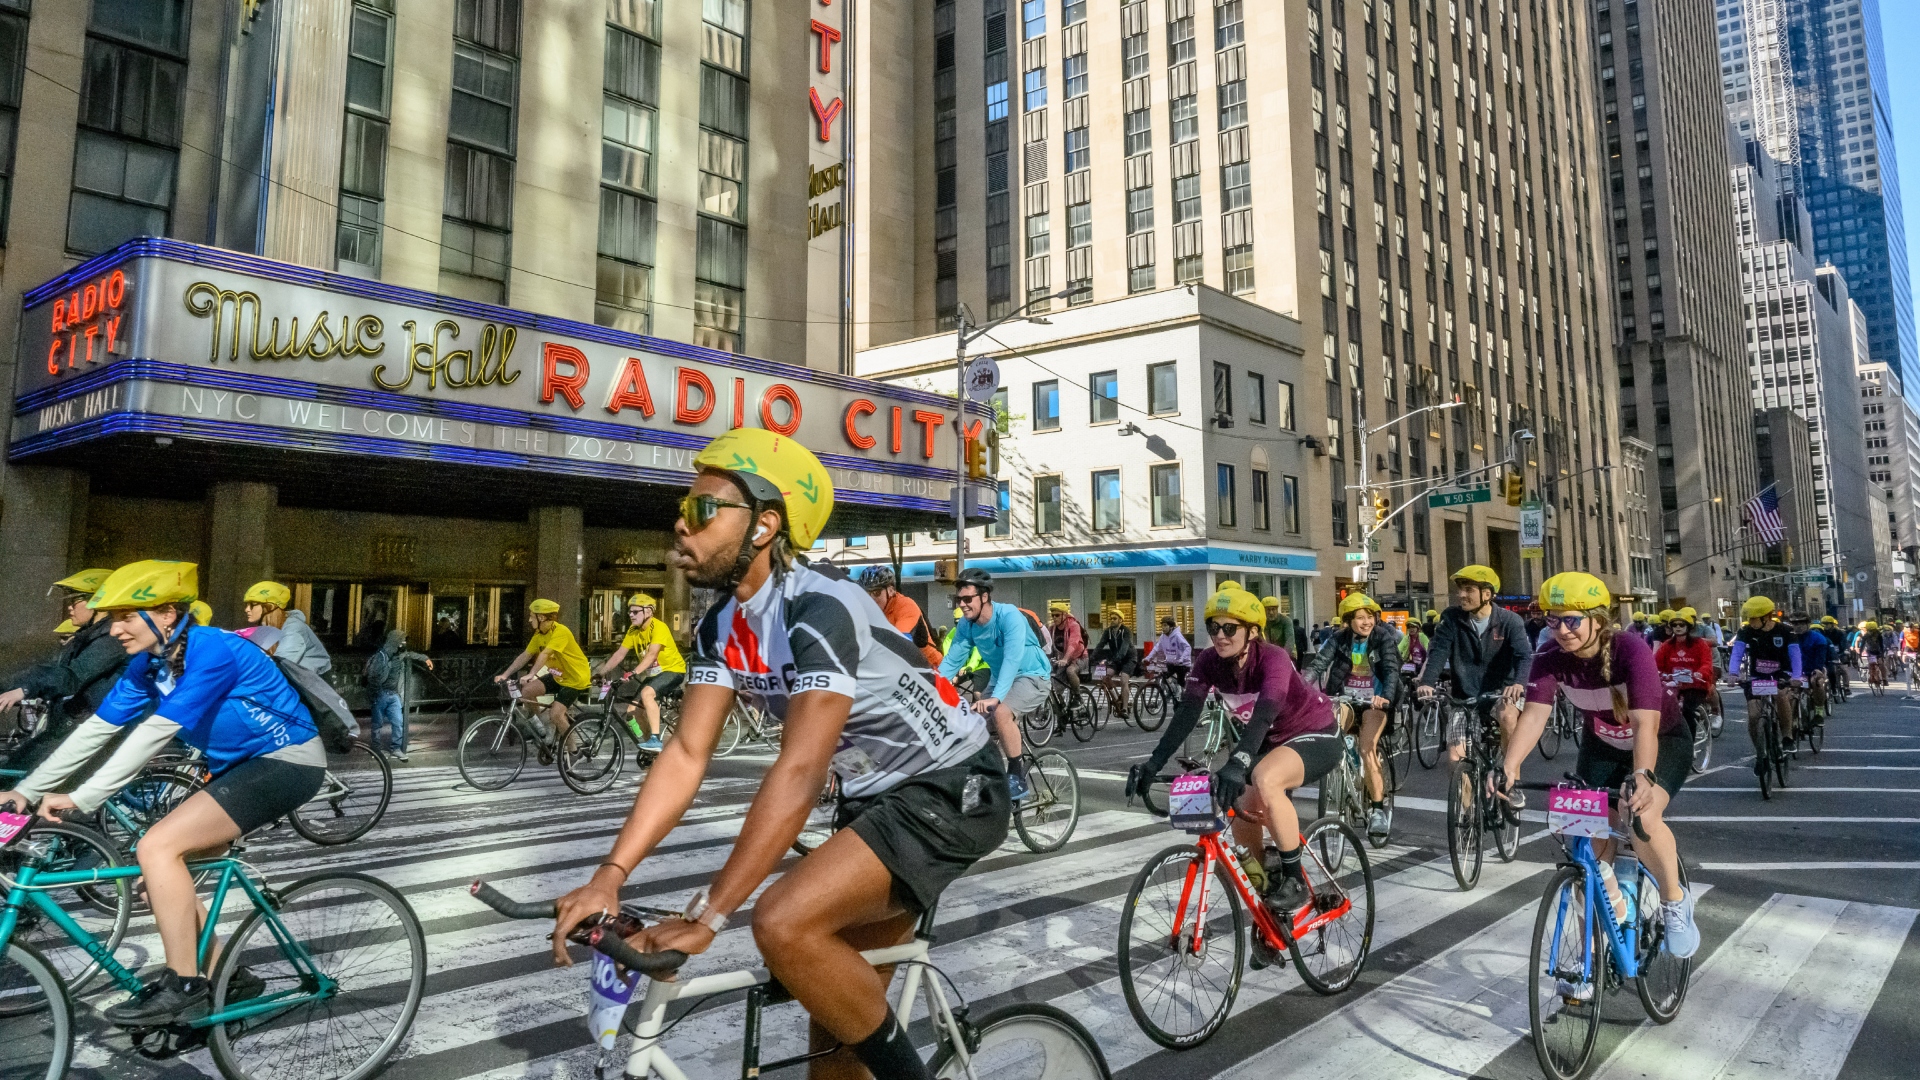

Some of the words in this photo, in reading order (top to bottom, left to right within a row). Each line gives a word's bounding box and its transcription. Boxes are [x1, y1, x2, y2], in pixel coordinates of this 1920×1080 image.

[809, 0, 844, 142] TY
[808, 202, 842, 241] HALL
[52, 270, 124, 333] RADIO
[48, 316, 120, 374] CITY
[184, 281, 385, 362] Music
[371, 319, 522, 391] Hall
[39, 399, 77, 431] MUSIC
[84, 385, 118, 418] HALL
[541, 342, 803, 436] RADIO
[845, 399, 983, 463] CITY
[182, 387, 257, 420] NYC
[288, 399, 472, 444] WELCOMES
[499, 426, 545, 453] THE
[567, 435, 634, 462] 2023
[653, 446, 699, 468] FIVE
[902, 478, 936, 497] RIDE
[1444, 496, 1451, 504] W
[1453, 494, 1464, 503] 50
[1466, 493, 1475, 502] St
[1032, 558, 1068, 569] WARBY
[1073, 556, 1114, 567] PARKER
[1239, 553, 1262, 565] WARBY
[1264, 555, 1288, 566] PARKER
[892, 690, 921, 718] RACING
[1599, 726, 1634, 737] 2463
[1172, 781, 1209, 793] 23304
[1553, 796, 1602, 813] 24631
